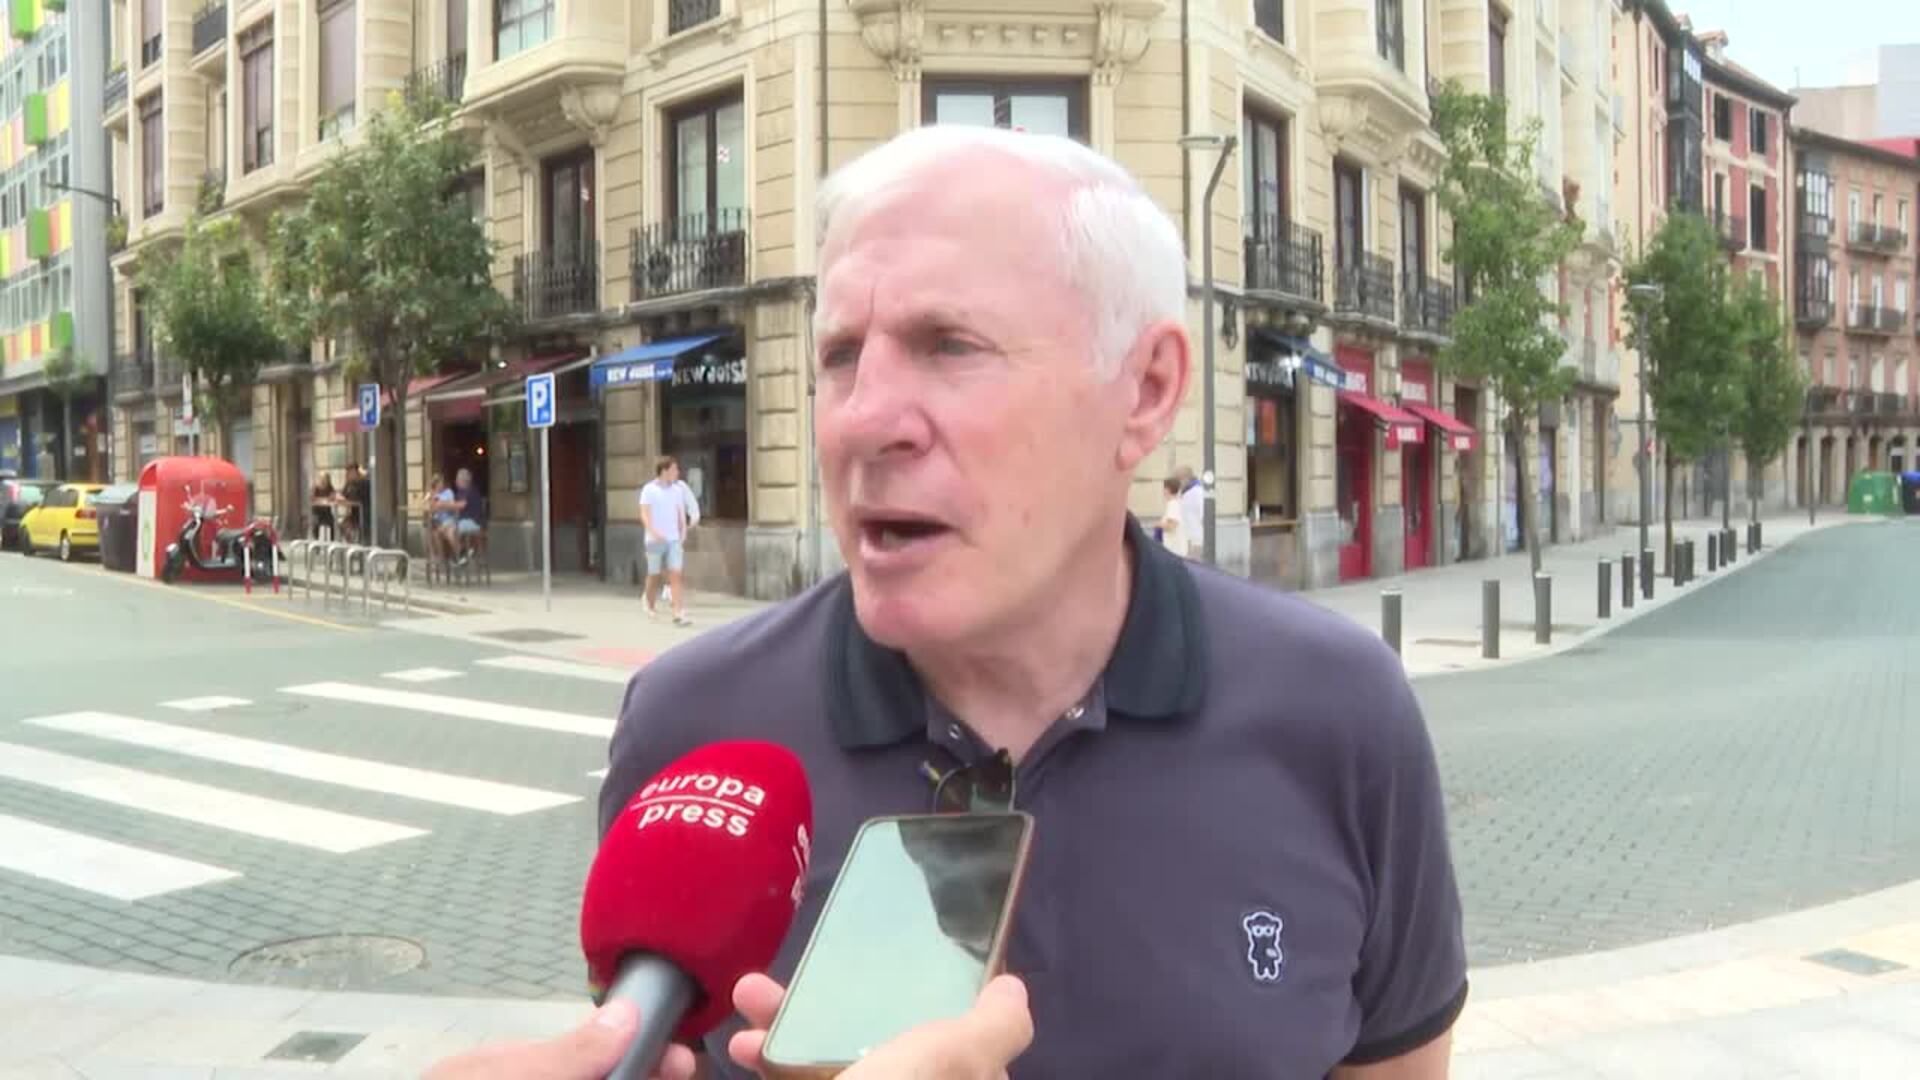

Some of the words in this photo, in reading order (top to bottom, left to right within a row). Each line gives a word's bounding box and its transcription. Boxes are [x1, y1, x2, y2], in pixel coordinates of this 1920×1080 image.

[362, 390, 374, 422] P
[531, 382, 548, 421] P
[640, 773, 766, 807] europa
[638, 803, 750, 837] press
